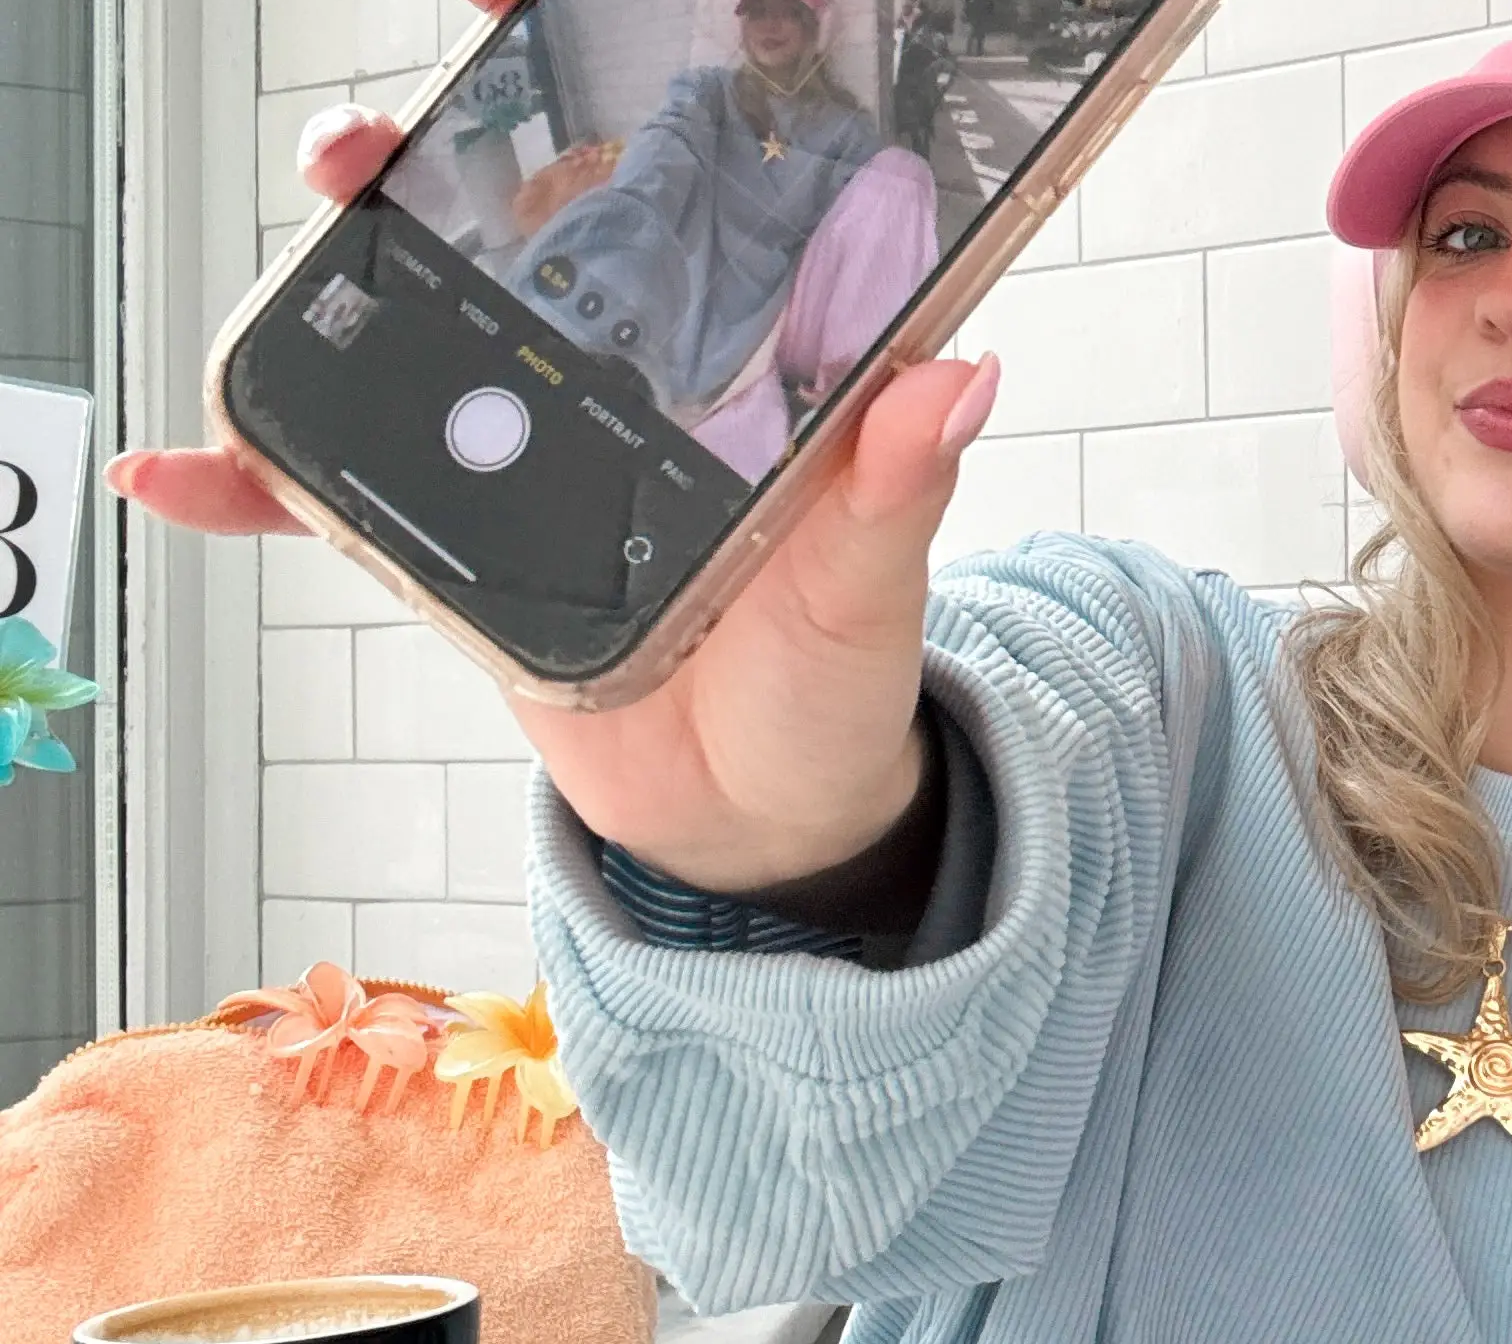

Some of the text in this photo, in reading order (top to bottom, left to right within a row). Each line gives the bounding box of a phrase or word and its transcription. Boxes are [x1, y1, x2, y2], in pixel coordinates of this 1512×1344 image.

[459, 298, 500, 336] VIDEO
[516, 345, 564, 385] PHOTO
[580, 397, 645, 449] PORTRAIT
